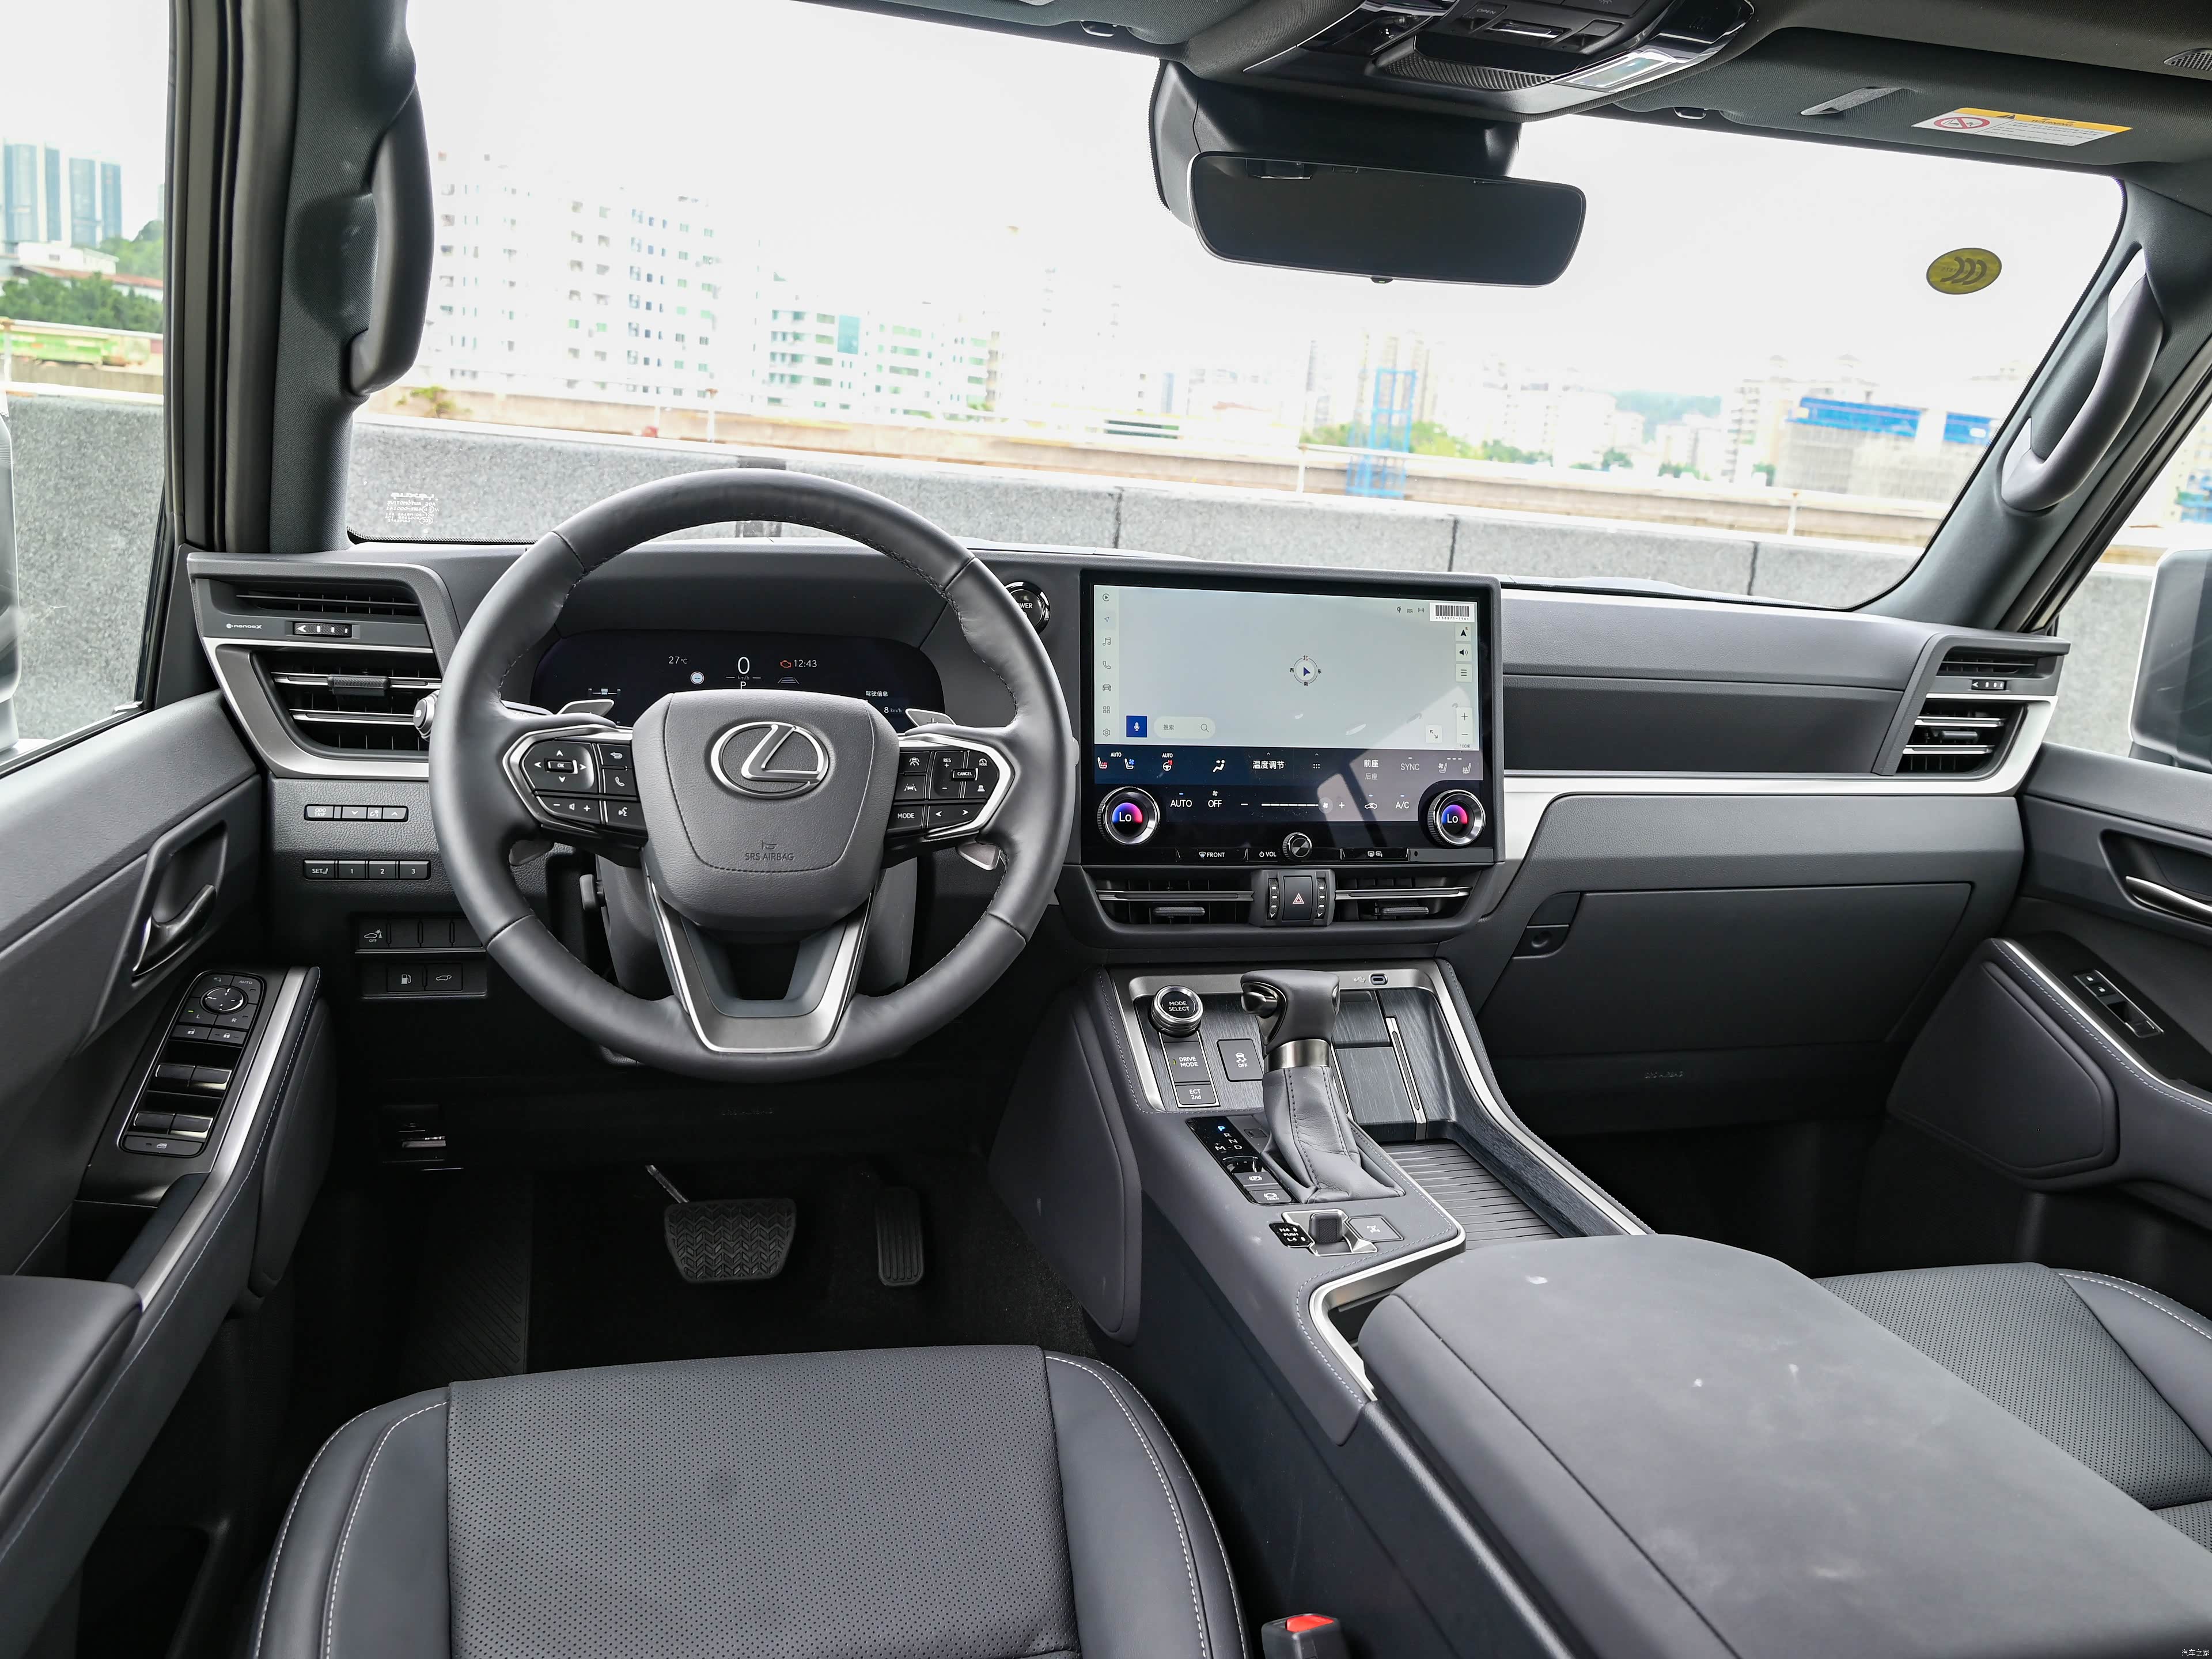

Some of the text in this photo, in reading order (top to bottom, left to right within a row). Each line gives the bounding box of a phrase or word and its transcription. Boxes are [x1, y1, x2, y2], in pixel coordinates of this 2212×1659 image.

[737, 657, 750, 675] 0
[793, 660, 817, 668] 12:43
[740, 681, 747, 690] P
[1252, 760, 1285, 770] 温度调节
[1363, 759, 1379, 768] 前座
[1171, 800, 1192, 808] AUTO
[1208, 800, 1222, 808] OFF
[1395, 801, 1410, 809] A/C
[745, 853, 795, 861] SRS AIRBAG
